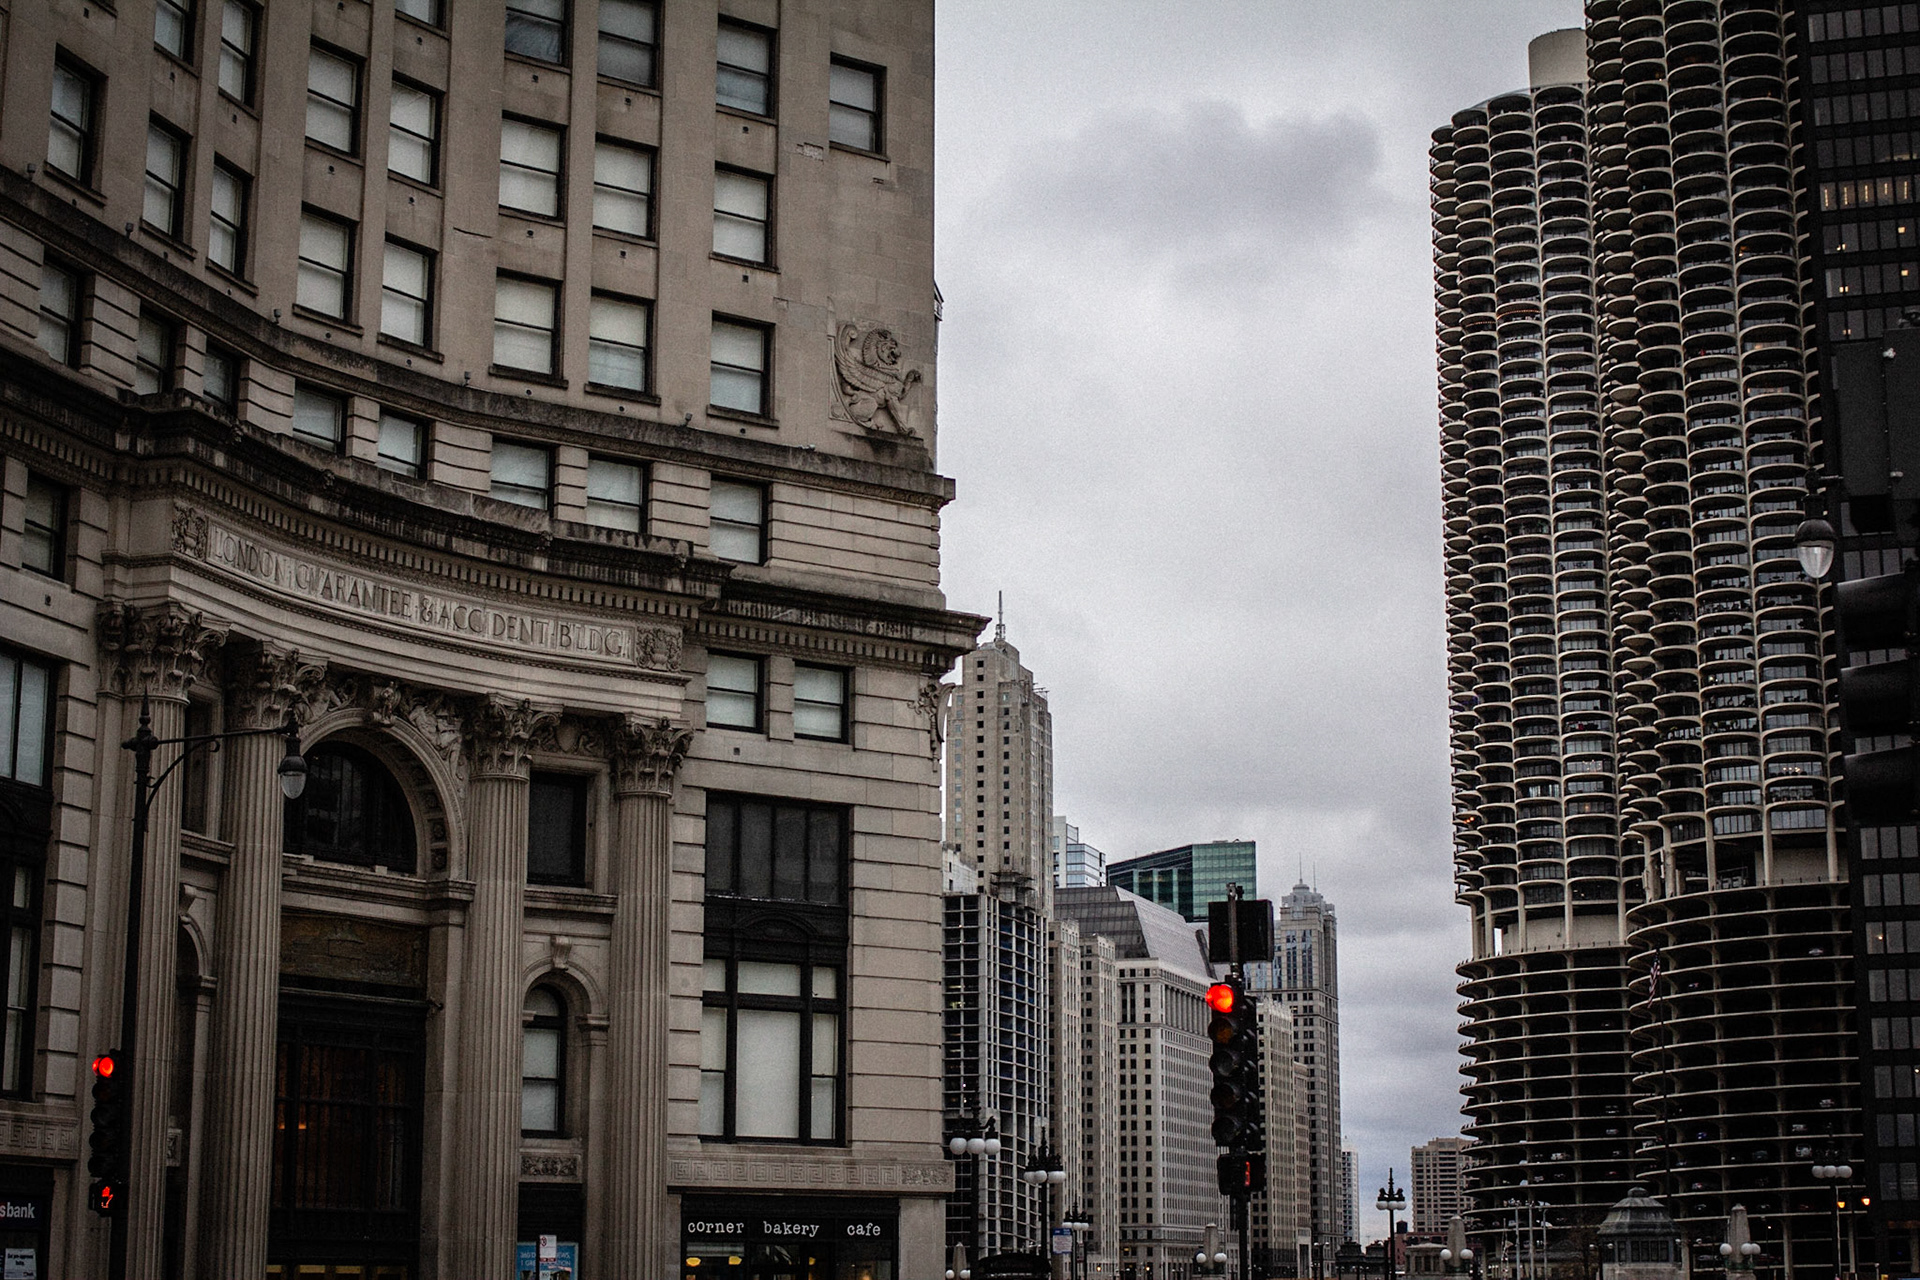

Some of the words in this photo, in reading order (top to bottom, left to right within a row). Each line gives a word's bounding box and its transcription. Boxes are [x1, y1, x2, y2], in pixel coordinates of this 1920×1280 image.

[215, 529, 288, 582] LONDON
[687, 1220, 745, 1234] corner
[763, 1220, 820, 1238] bakery
[846, 1222, 882, 1237] cafe
